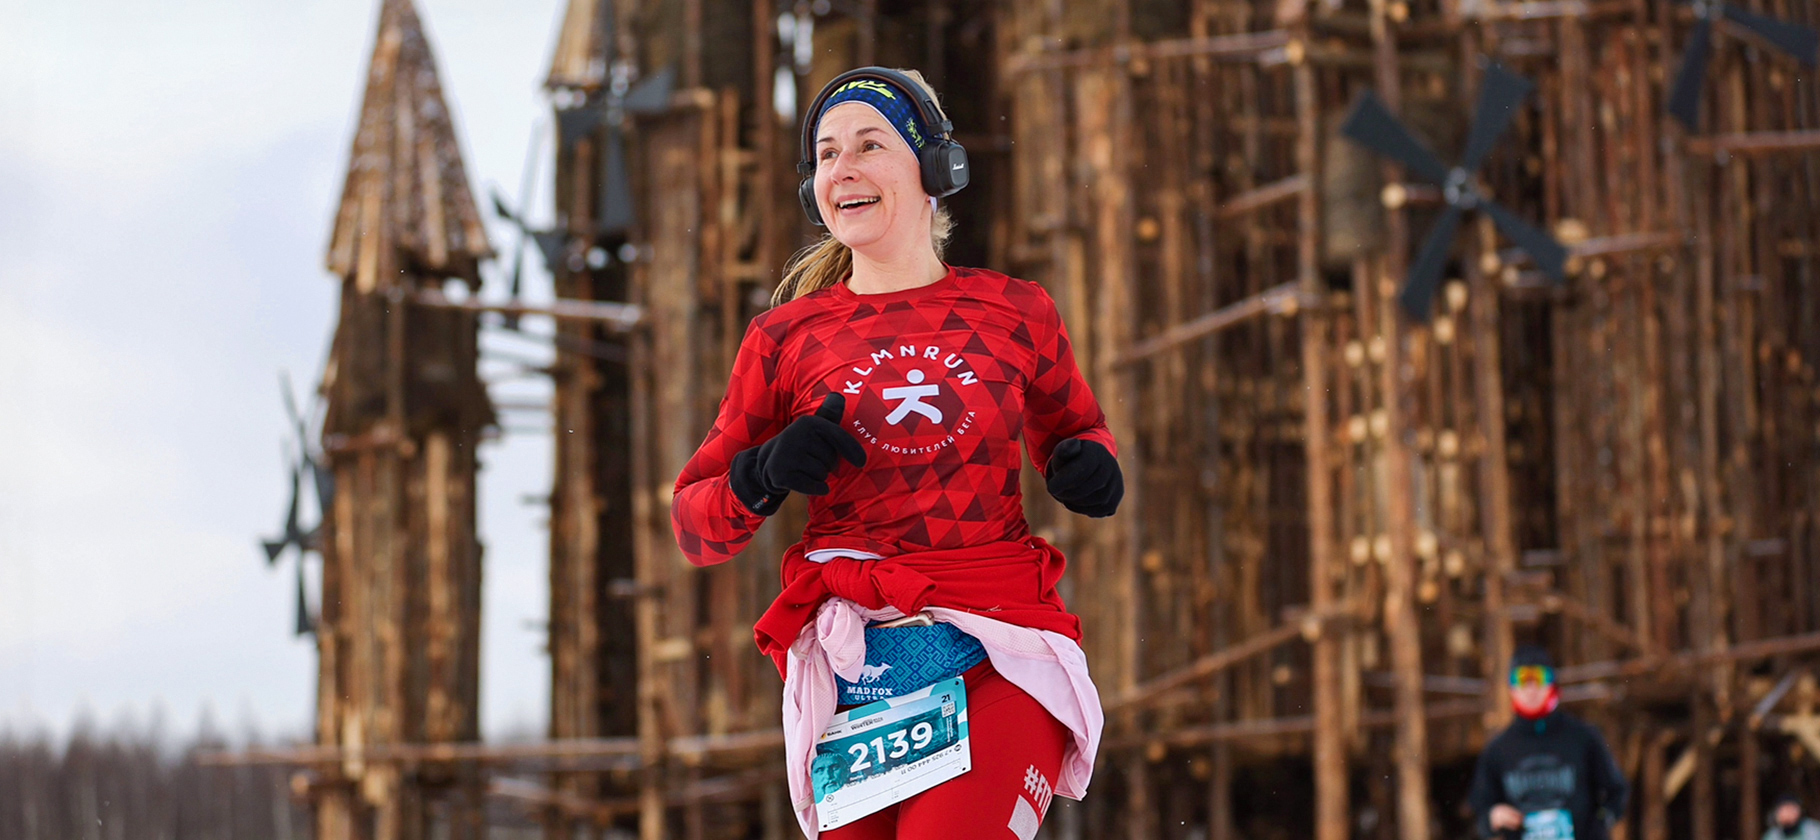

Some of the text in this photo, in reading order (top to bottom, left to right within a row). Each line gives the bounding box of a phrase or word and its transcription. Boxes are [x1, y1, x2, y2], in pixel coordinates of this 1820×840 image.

[843, 345, 978, 394] KLMNRUN
[853, 411, 976, 454] КЛУБ ЛЮБИТЕЛЕЙ БЕГА
[846, 686, 893, 696] MAD FOX
[941, 694, 951, 703] 21
[847, 722, 934, 773] 2139
